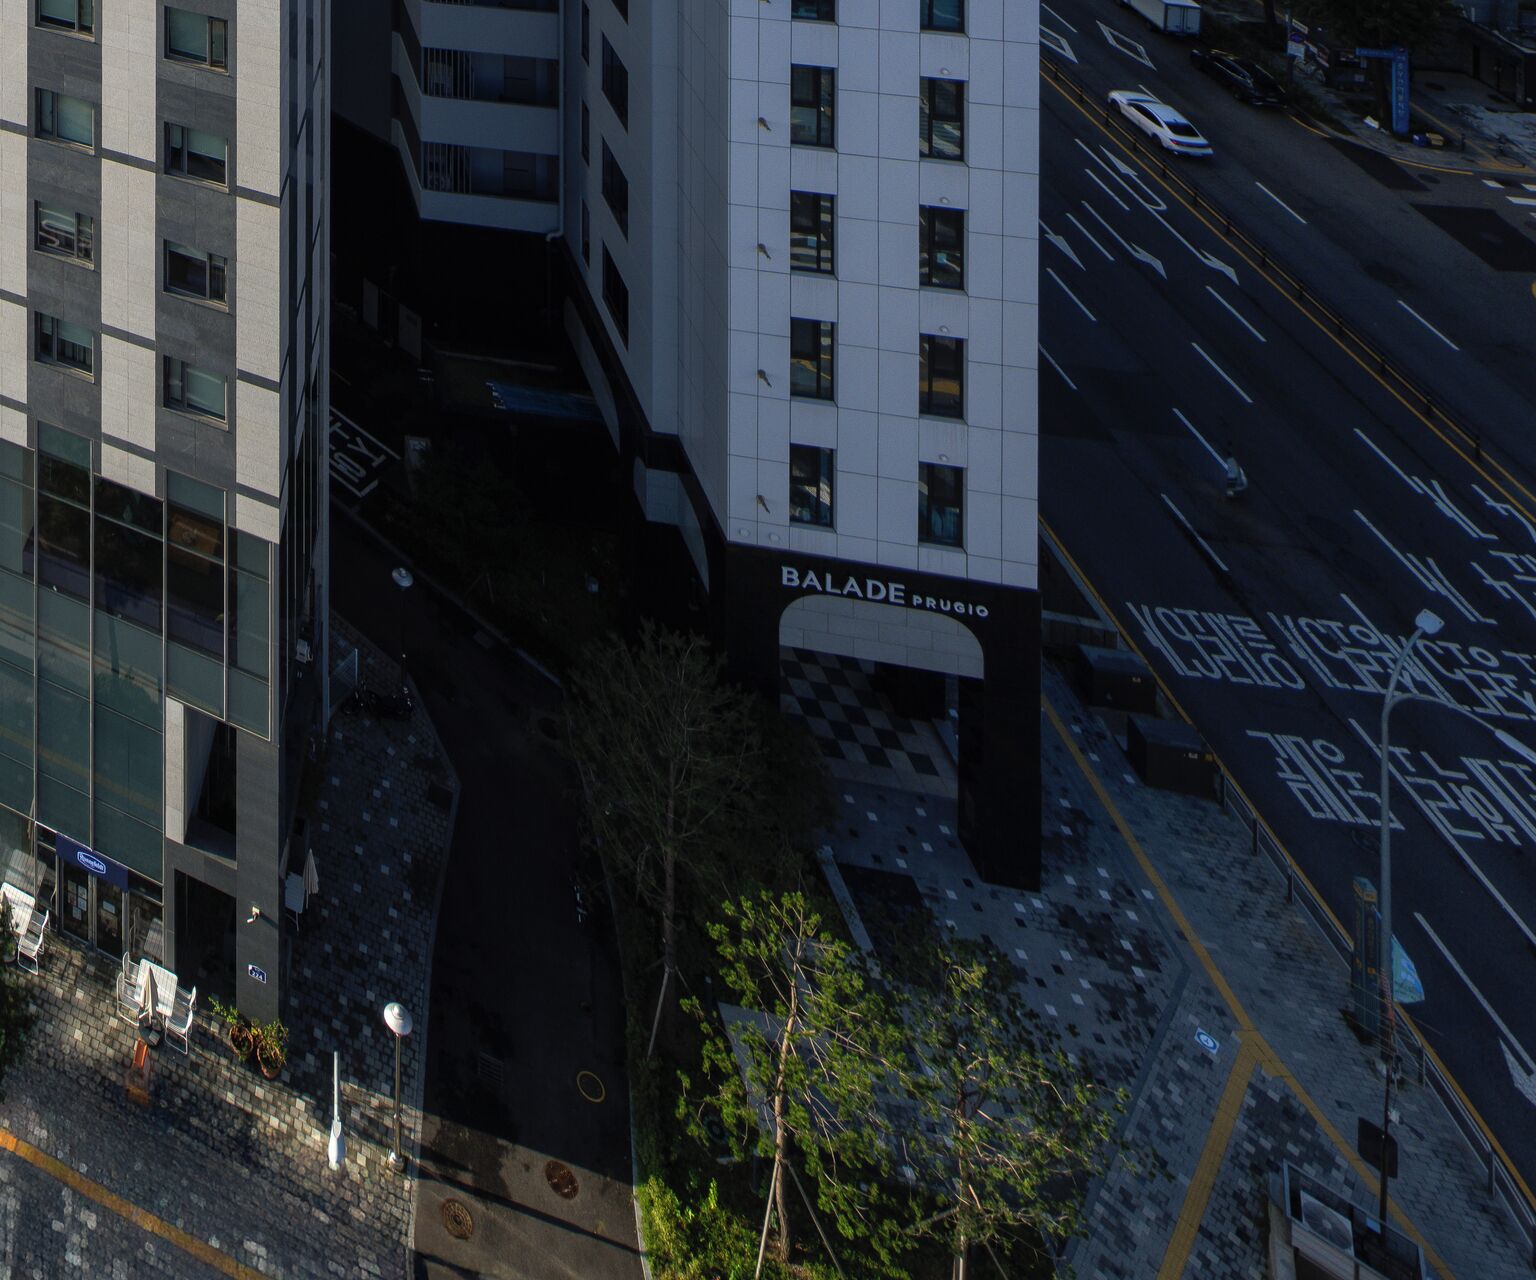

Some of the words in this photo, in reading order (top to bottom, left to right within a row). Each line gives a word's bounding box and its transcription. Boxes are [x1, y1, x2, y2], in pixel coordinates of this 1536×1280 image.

[781, 565, 906, 605] BALADE
[912, 595, 990, 618] PRUGIO
[1125, 600, 1306, 691] 을지로6가
[1246, 729, 1407, 832] 동대문
